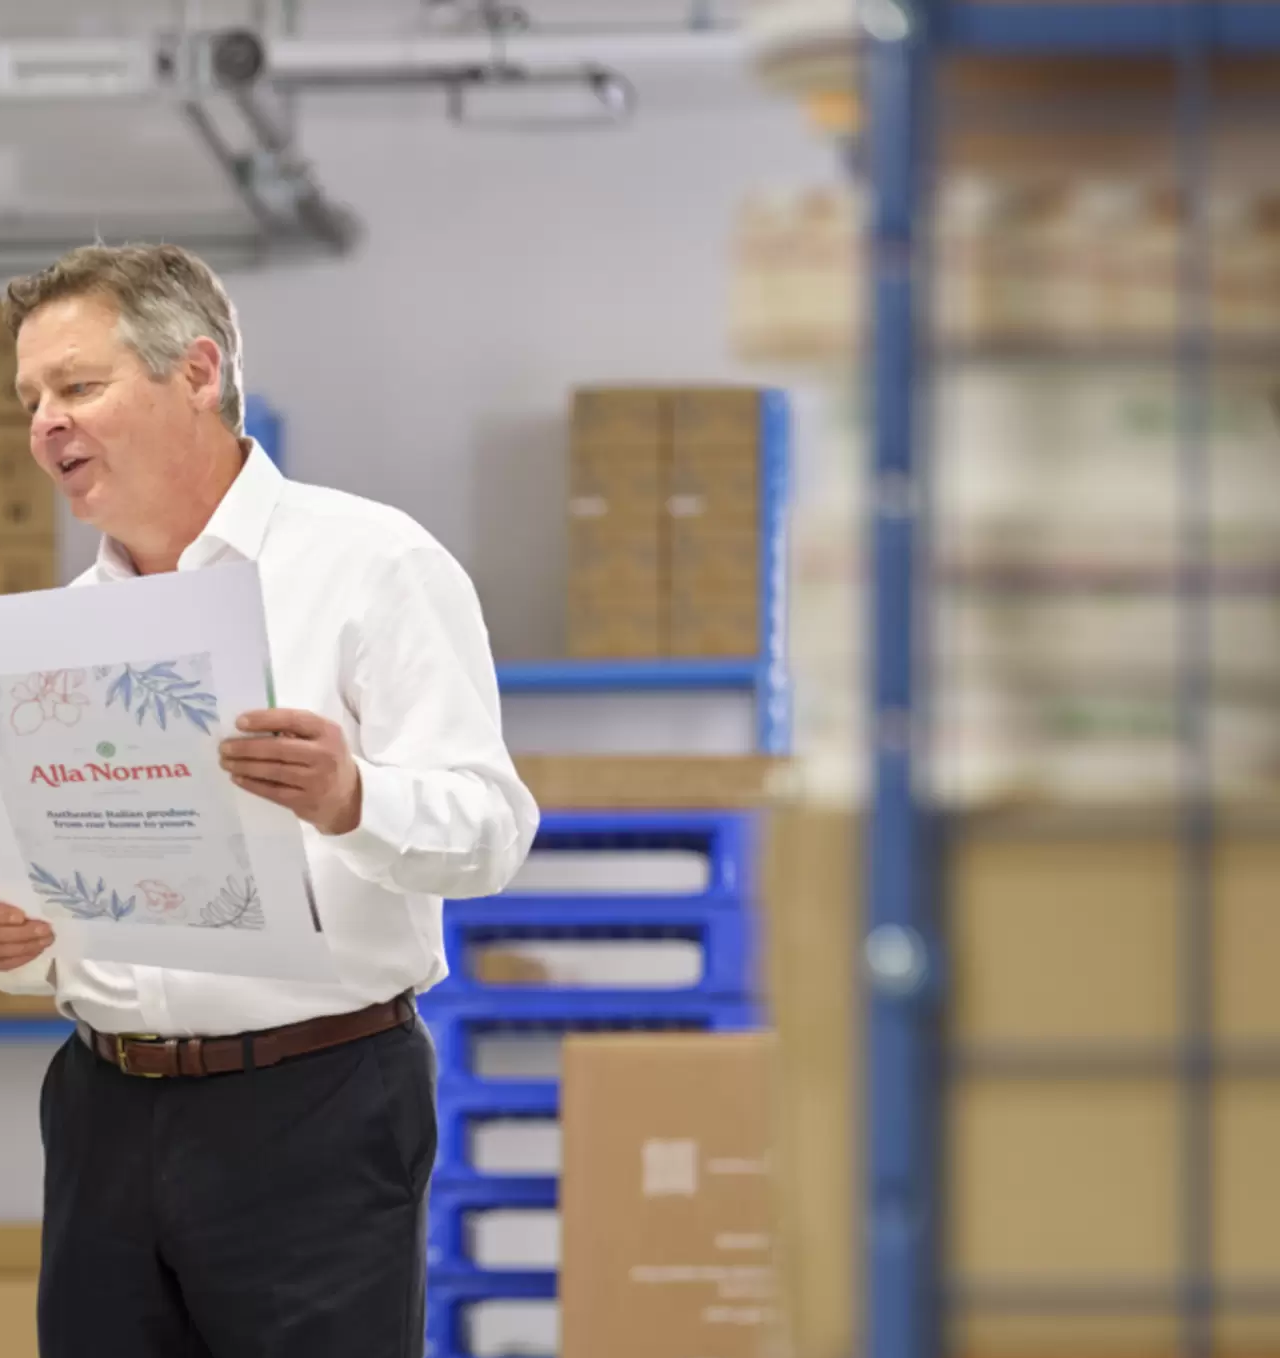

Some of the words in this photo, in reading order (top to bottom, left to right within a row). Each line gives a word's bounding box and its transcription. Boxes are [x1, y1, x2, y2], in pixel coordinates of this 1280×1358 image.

[31, 763, 86, 787] Alla
[84, 763, 191, 782] Norma
[46, 809, 103, 819] Authentic
[105, 809, 144, 819] Italian
[53, 820, 83, 829] from
[107, 819, 141, 829] home
